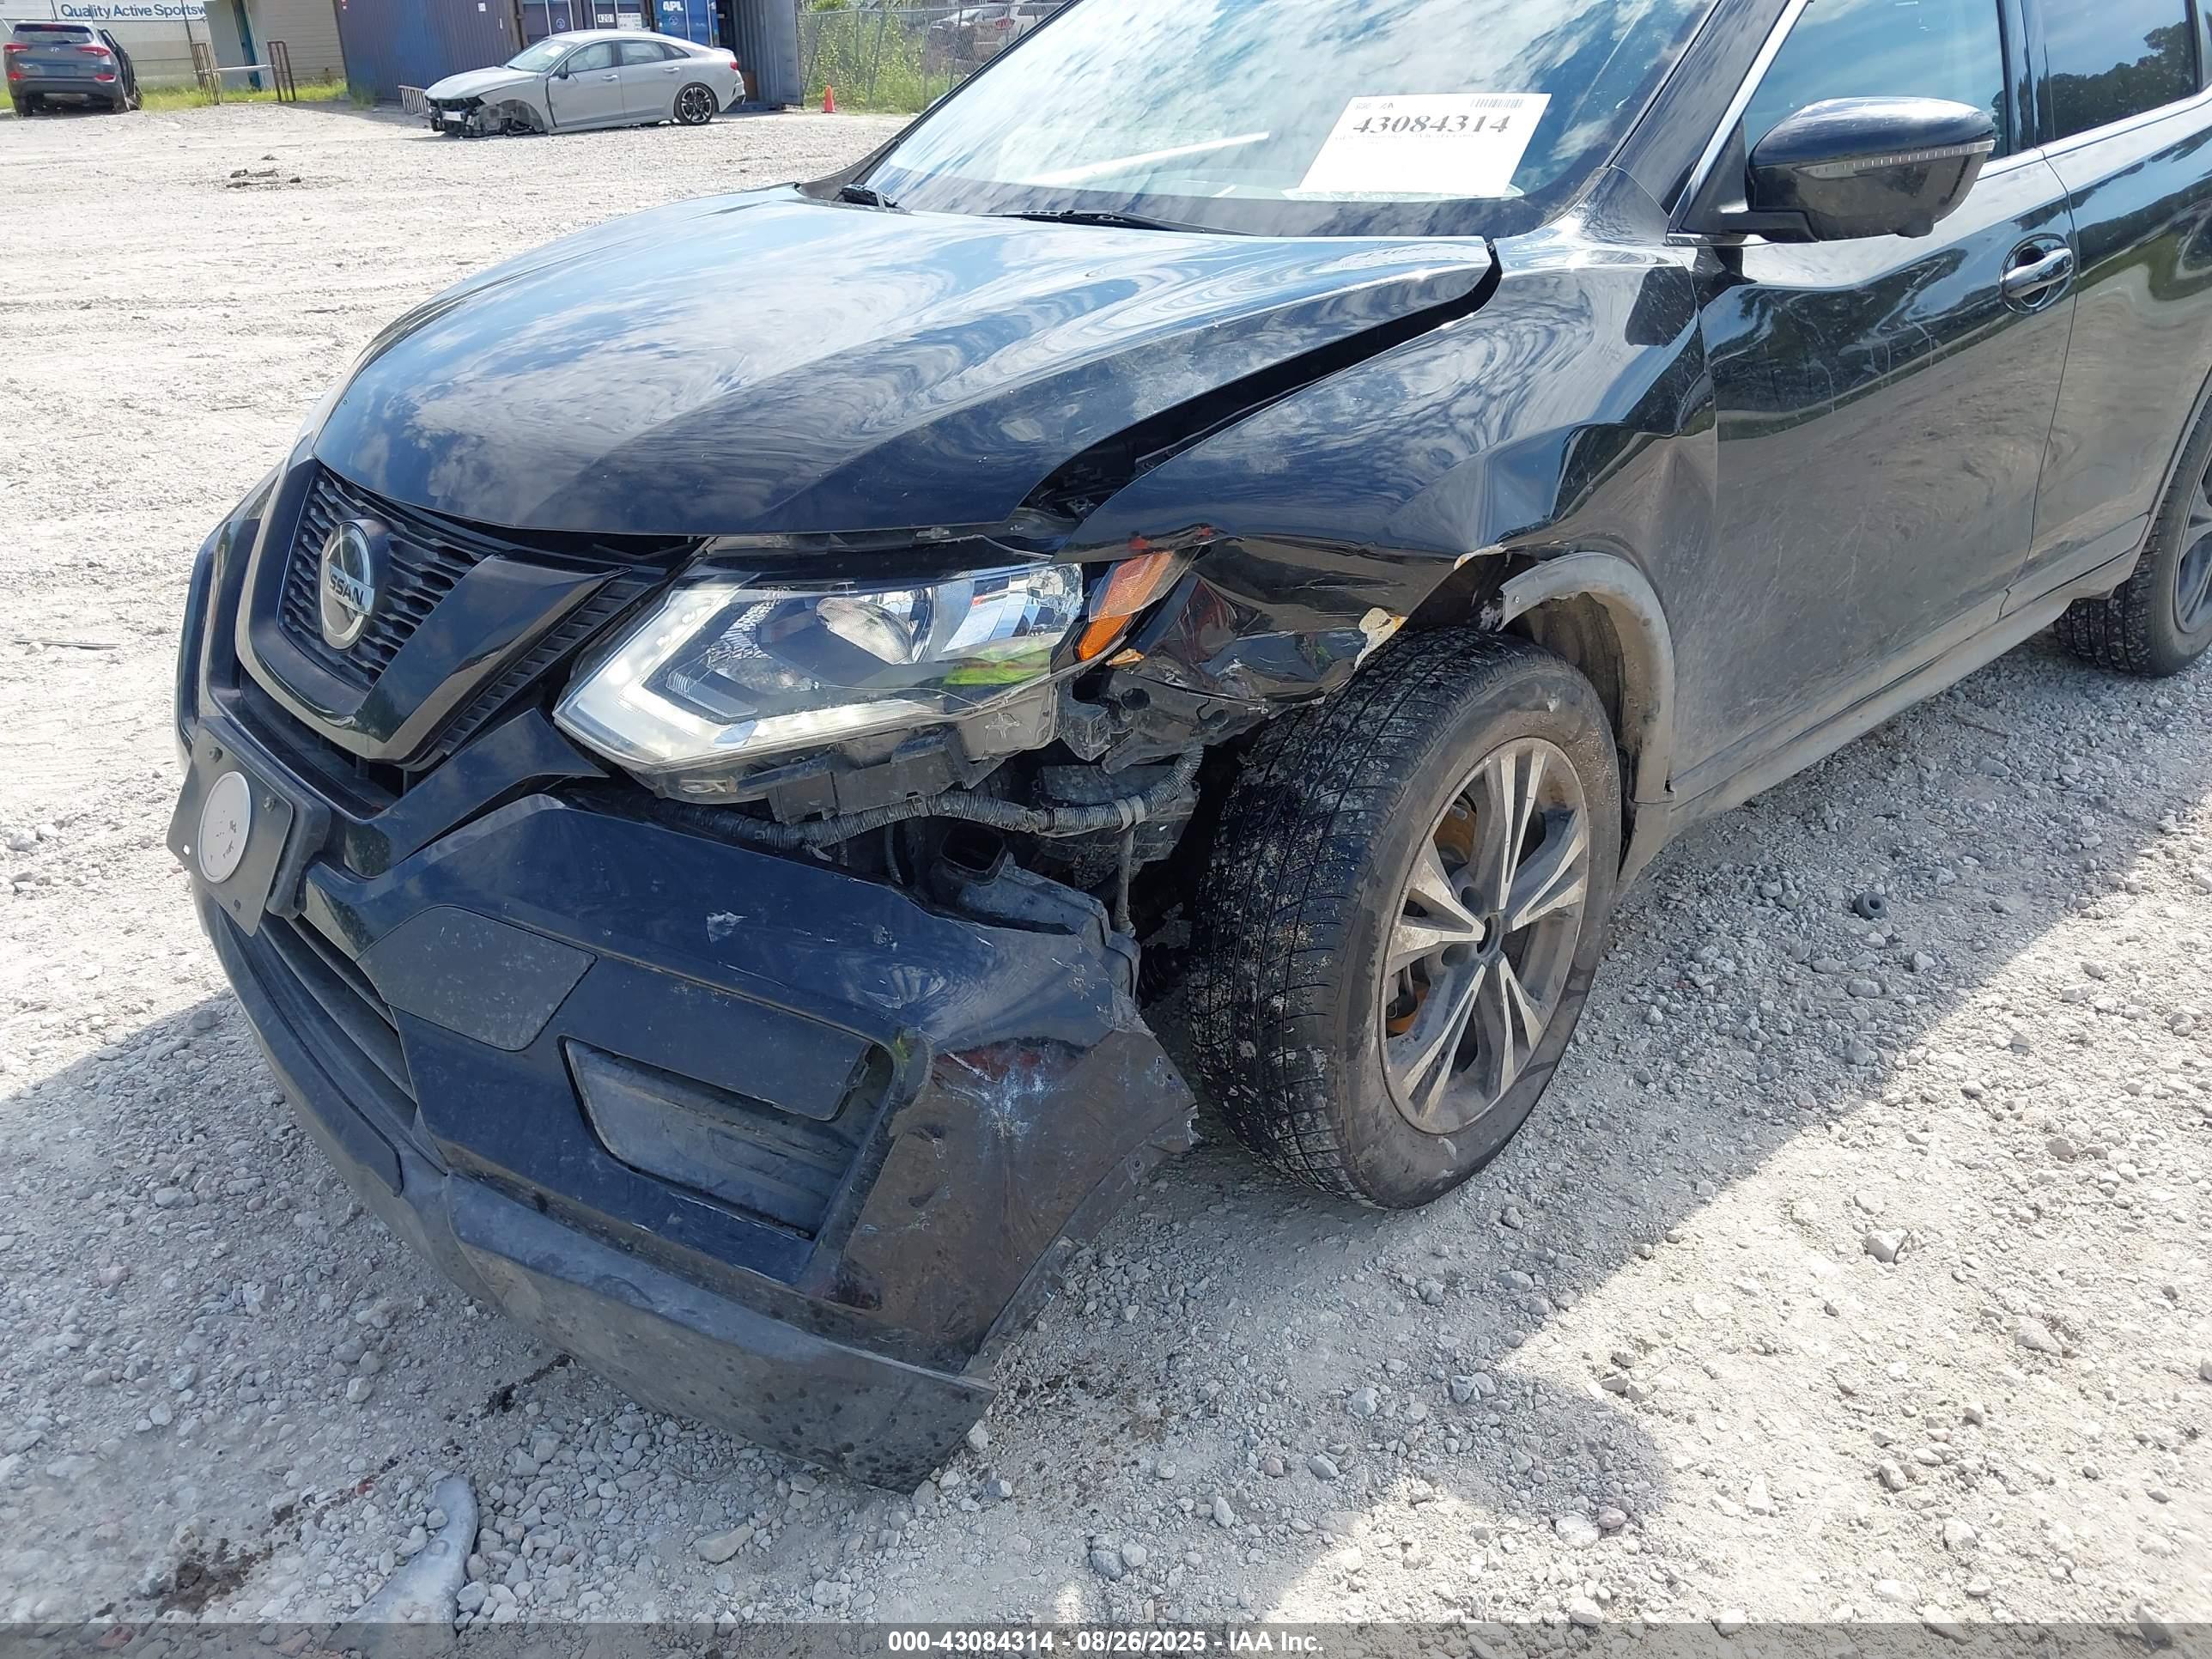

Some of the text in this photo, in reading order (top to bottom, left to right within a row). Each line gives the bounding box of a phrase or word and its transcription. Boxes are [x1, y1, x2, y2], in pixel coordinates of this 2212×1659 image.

[60, 3, 111, 19] Quality
[113, 3, 152, 16] Active
[663, 1, 684, 11] APL
[1352, 115, 1511, 133] 43084314
